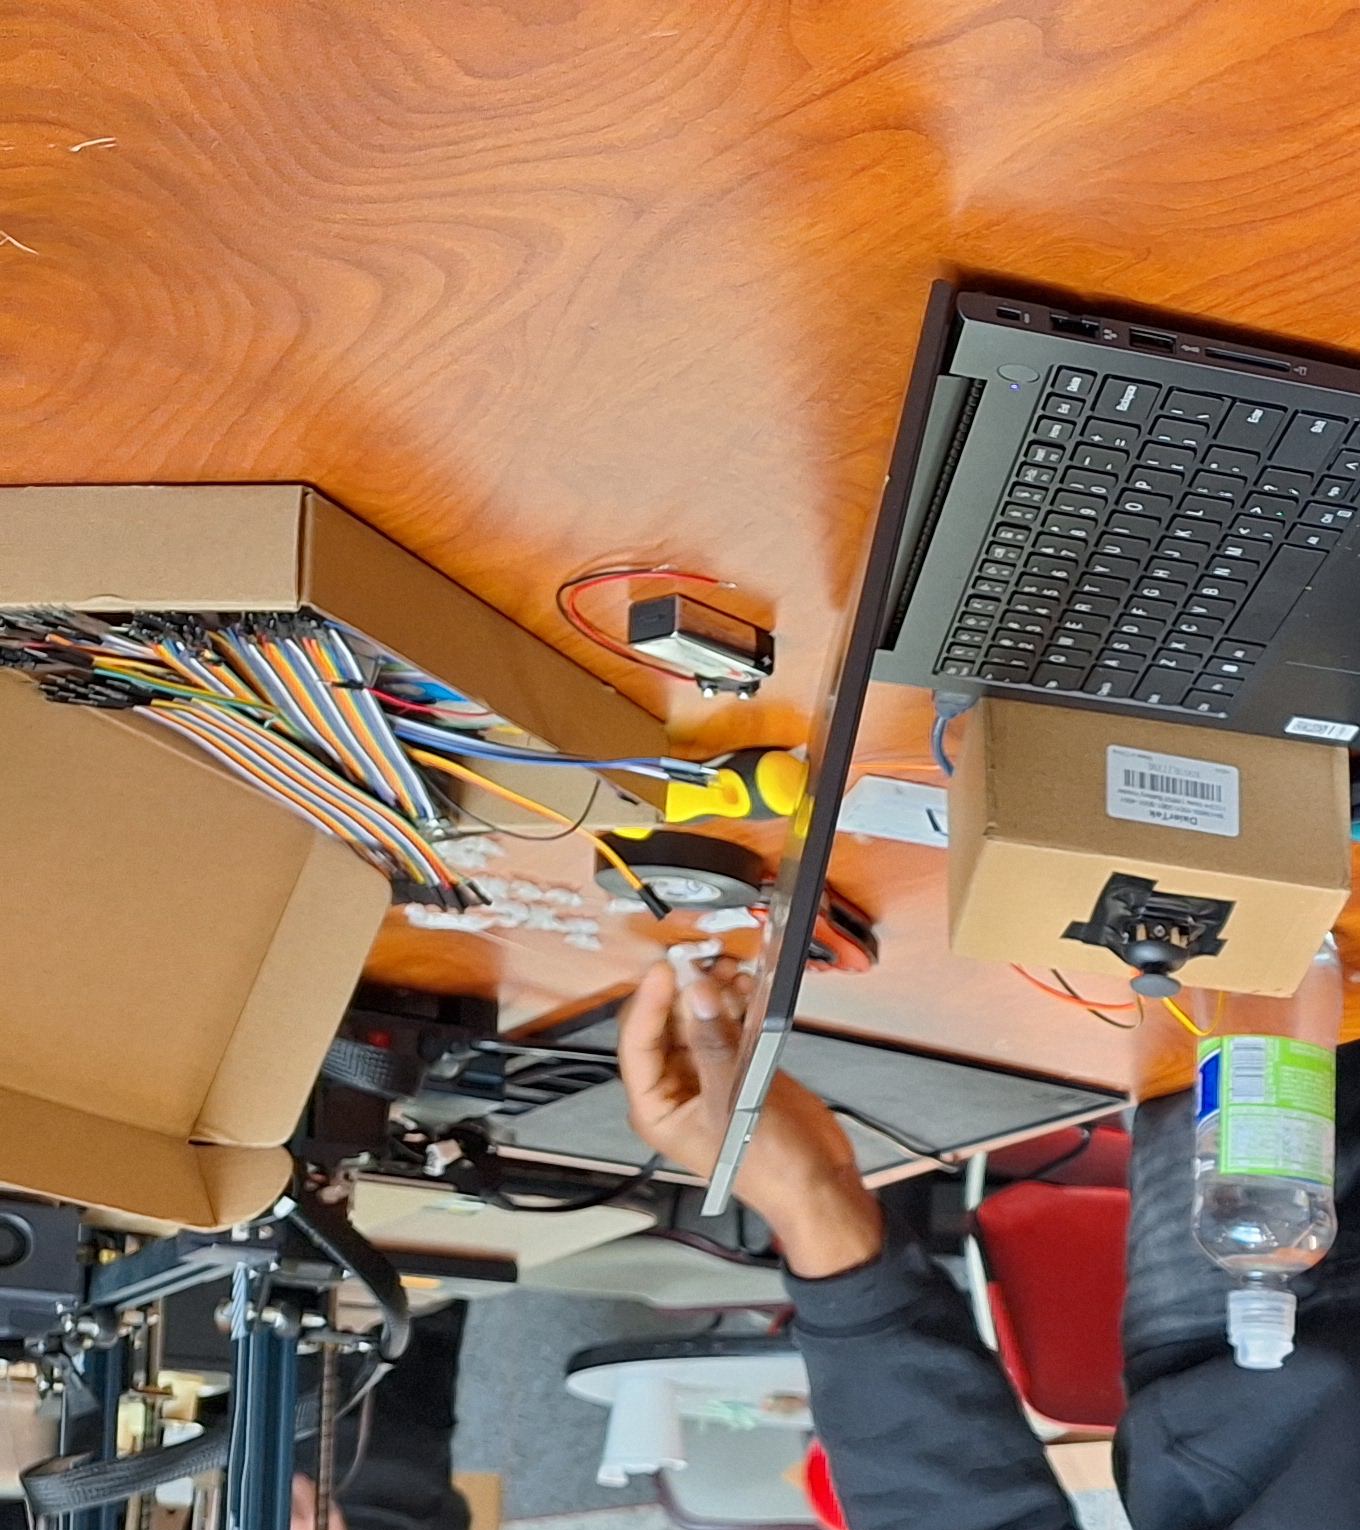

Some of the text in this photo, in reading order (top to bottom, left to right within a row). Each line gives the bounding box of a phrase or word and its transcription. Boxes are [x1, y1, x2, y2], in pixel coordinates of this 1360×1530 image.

[1134, 480, 1152, 490] P
[1124, 502, 1143, 511] O
[1103, 545, 1121, 554] U
[1083, 584, 1100, 592] T
[1112, 642, 1130, 650] S
[1121, 625, 1139, 633] D
[1131, 607, 1147, 616] F
[1142, 588, 1160, 597] G
[1152, 569, 1170, 578] H
[1164, 550, 1181, 558] J
[1174, 529, 1192, 538] K
[1074, 603, 1092, 612] R
[1159, 658, 1177, 667] Z
[1170, 642, 1186, 650] X
[1180, 624, 1198, 632] C
[1201, 587, 1219, 596] B
[1213, 567, 1231, 577] N
[1224, 546, 1243, 557] M
[1064, 621, 1083, 630] E
[1057, 636, 1074, 646] W
[1048, 655, 1066, 663] Q
